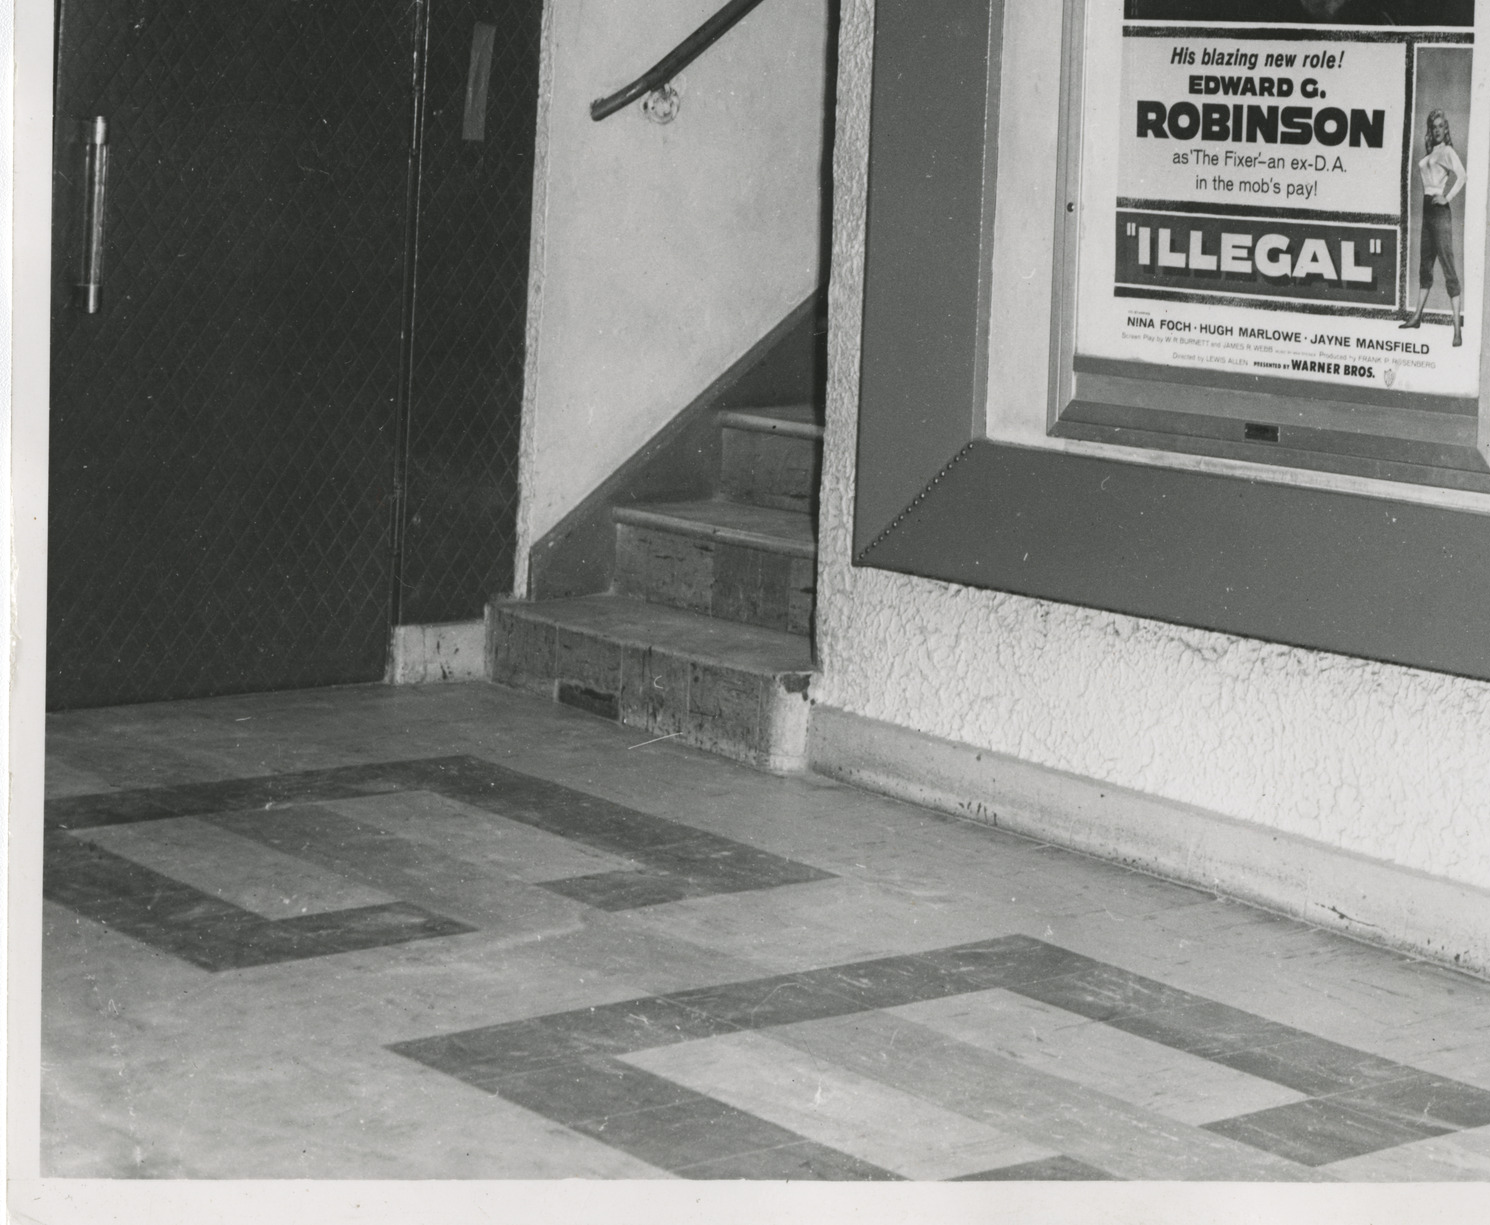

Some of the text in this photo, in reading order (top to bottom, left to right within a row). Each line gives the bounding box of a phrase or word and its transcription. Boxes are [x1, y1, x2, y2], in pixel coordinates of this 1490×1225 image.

[1170, 47, 1345, 70] His blazing new role!
[1188, 75, 1326, 99] EDWARD G.
[1136, 100, 1386, 149] ROBINSON
[1172, 152, 1189, 165] as
[1195, 175, 1318, 200] in the mob's pay!
[1127, 222, 1382, 283] "ILLEGAL"
[1127, 316, 1430, 355] NINA FOCH HUGH MARLOWE JAYNE MANSFIELD
[1253, 361, 1281, 369] PRESENTED
[1291, 359, 1341, 376] WARNER
[1343, 364, 1375, 379] BROS.
